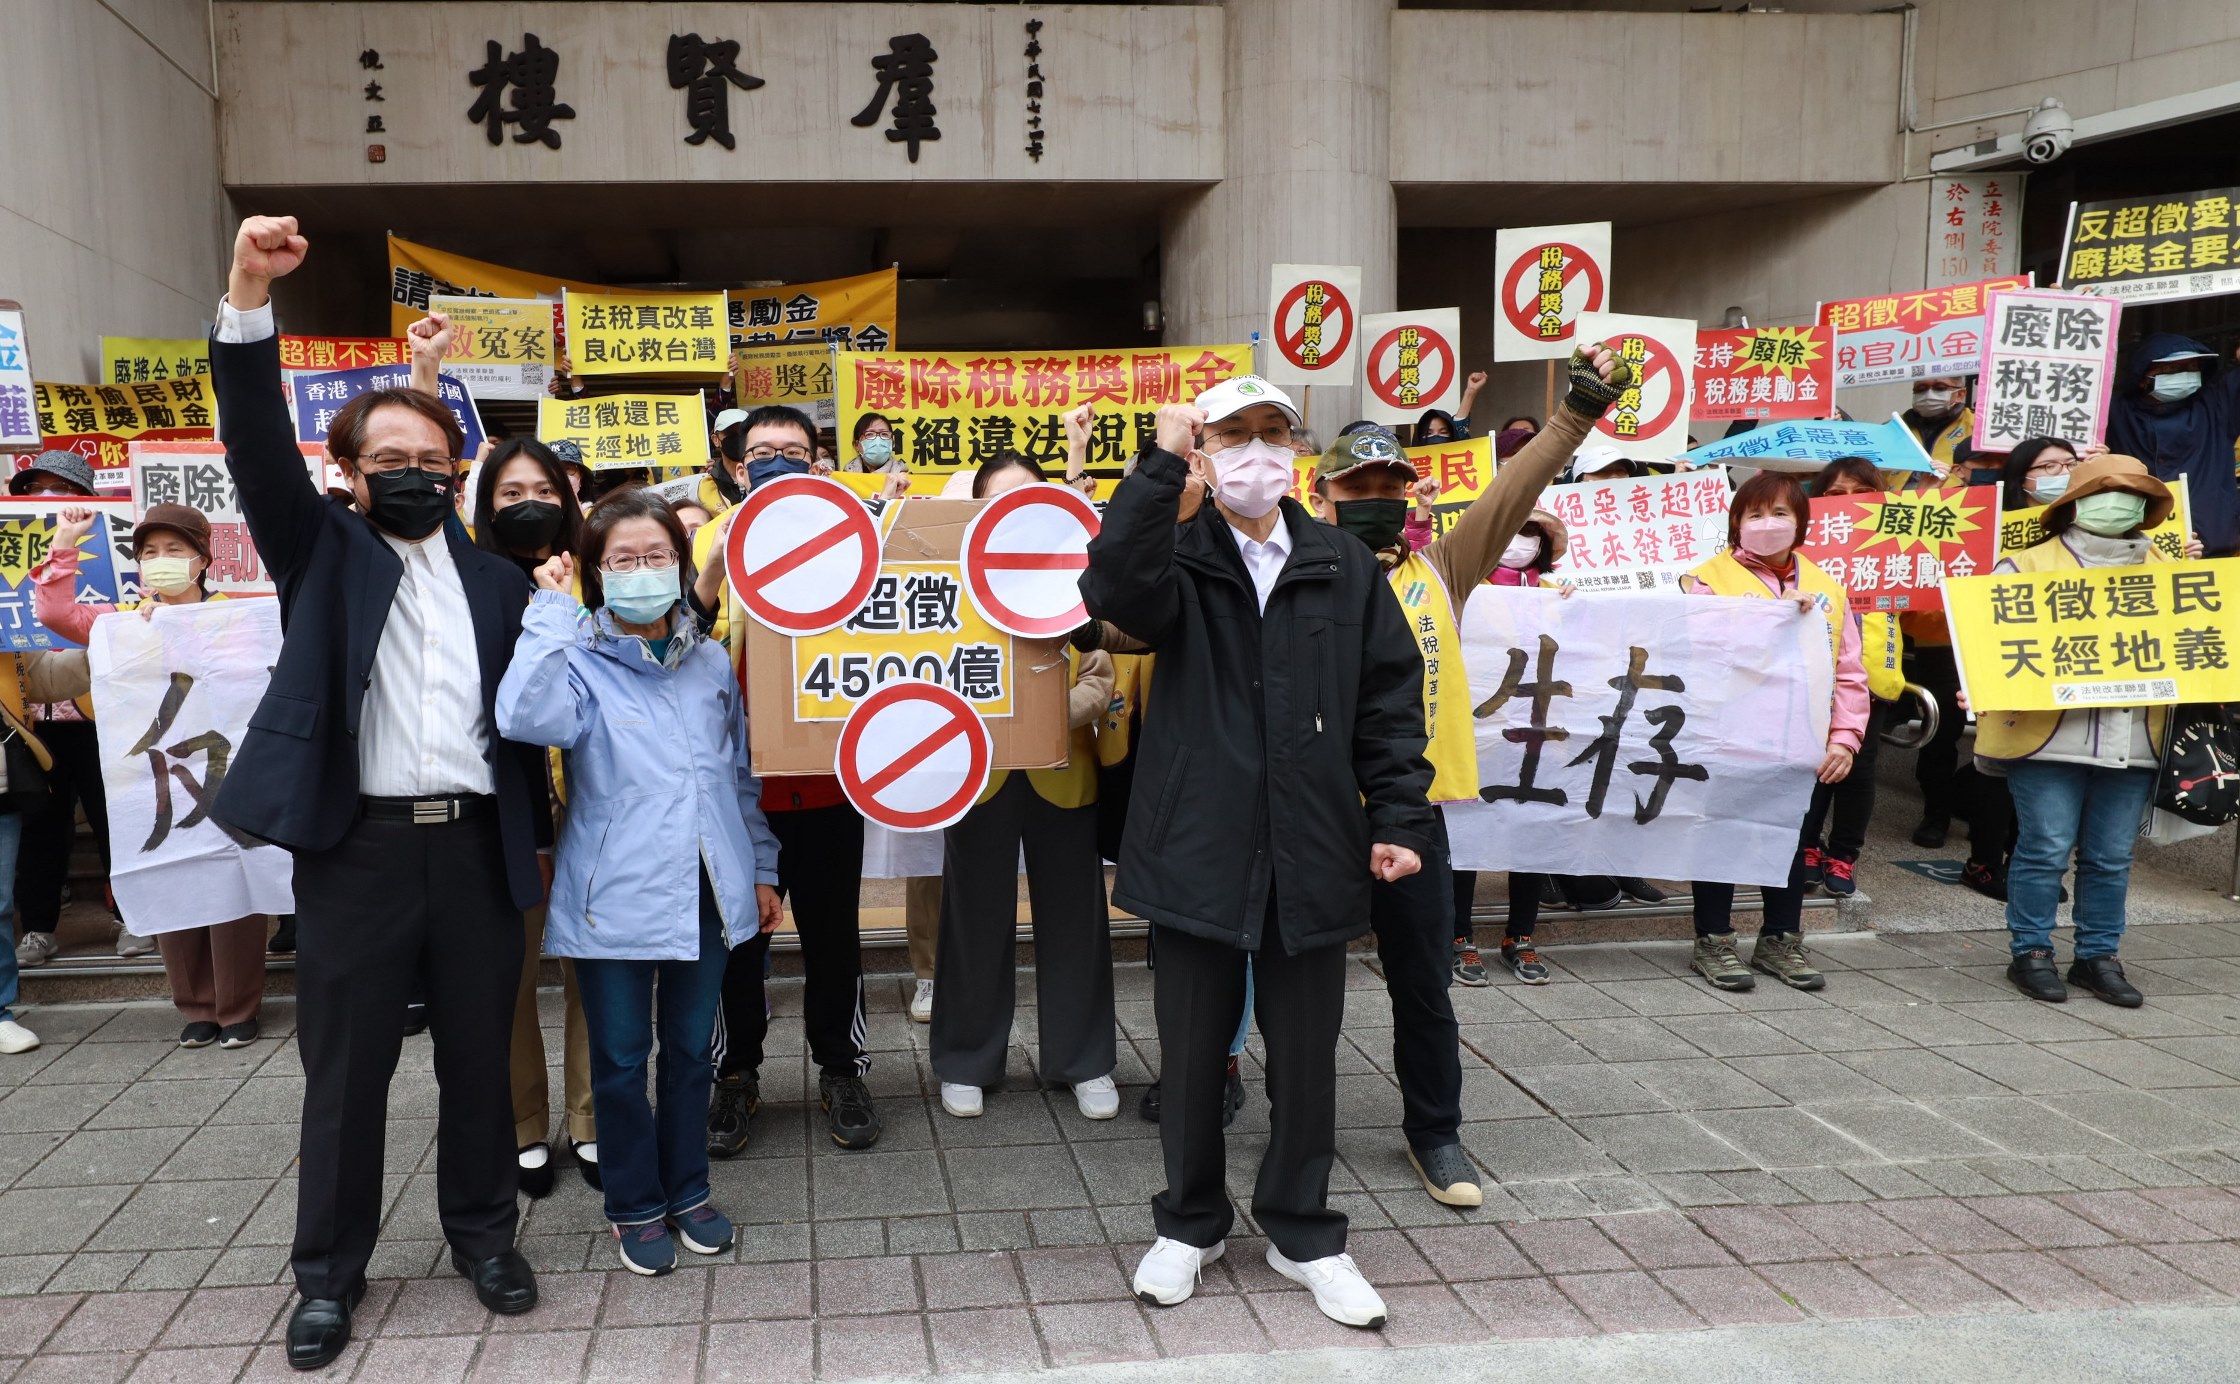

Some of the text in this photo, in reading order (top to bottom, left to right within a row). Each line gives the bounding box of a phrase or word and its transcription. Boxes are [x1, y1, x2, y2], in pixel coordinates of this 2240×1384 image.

[1941, 182, 1970, 284] 於右側150
[1980, 181, 2003, 281] 立法院委員
[2074, 196, 2240, 244] 反超徵愛
[2068, 233, 2240, 280] 廢獎金要
[1538, 246, 1564, 338] 稅務獎金
[581, 304, 714, 331] 法稅真改革
[1302, 283, 1325, 366] 稅務獎金
[2000, 304, 2104, 351] 廢除
[584, 337, 717, 363] 良心救台灣
[1398, 328, 1420, 406] 稅務獎金
[1748, 336, 1806, 366] 廢除
[854, 351, 1237, 411] 廢除稅務獎勵金
[1704, 373, 1819, 405] 稅務獎勵金
[565, 400, 680, 429] 超徵還民
[1990, 402, 2092, 444] 獎勵金
[1537, 477, 1731, 527] 絕惡意超徵
[1876, 502, 1958, 539] 廢除
[1552, 522, 1699, 569] 民來發聲
[847, 575, 960, 631] 超徵
[1990, 570, 2222, 625] 超徵還民
[2000, 625, 2230, 679] 天經地義
[1473, 634, 1710, 826] 生存
